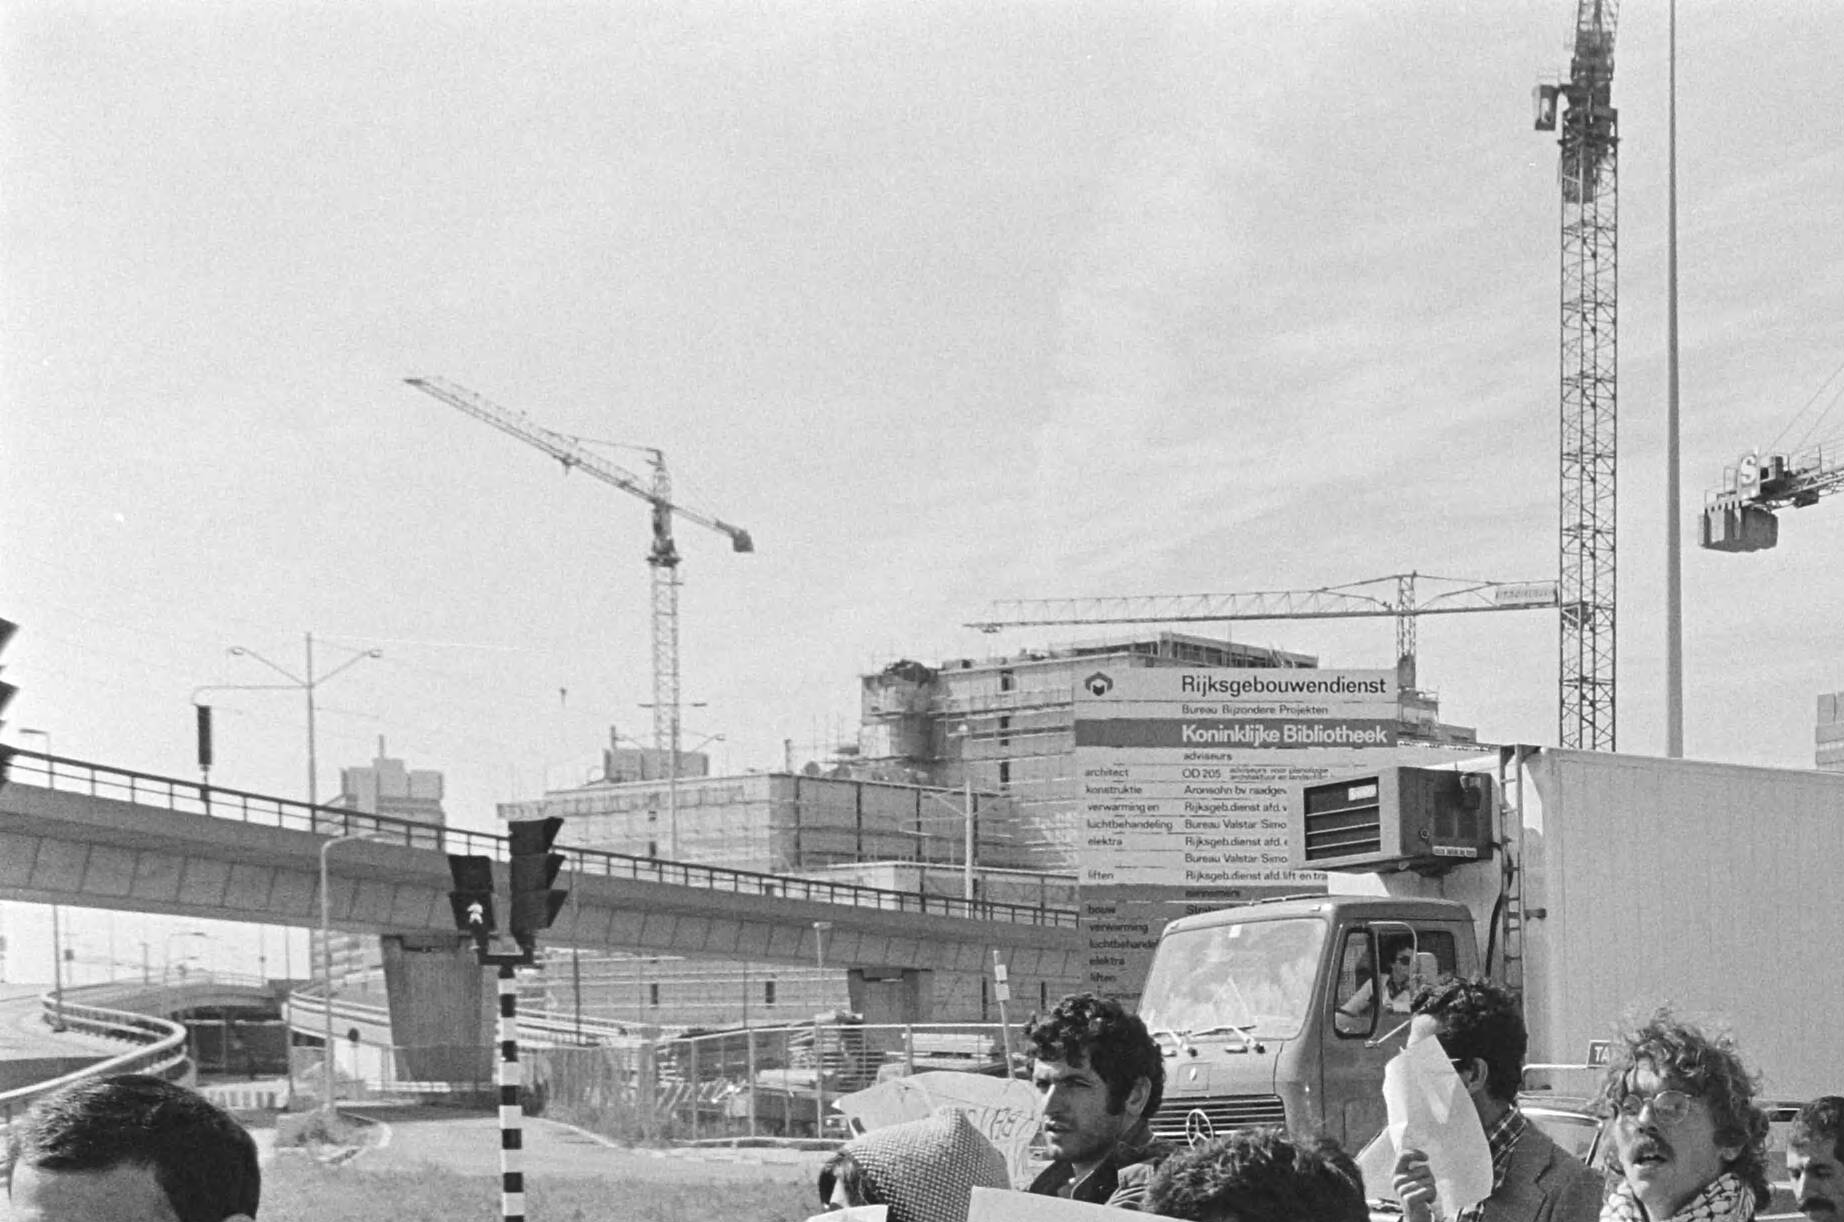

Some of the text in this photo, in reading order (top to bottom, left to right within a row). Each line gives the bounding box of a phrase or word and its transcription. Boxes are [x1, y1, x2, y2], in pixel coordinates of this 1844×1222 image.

[1181, 674, 1387, 698] Rijksgebouwendienst
[1181, 704, 1329, 717] Bureau Bijzondere Projekten
[1181, 724, 1388, 744] Koninklijke Bibliotheek
[1183, 751, 1233, 761] adviseurs
[1084, 767, 1129, 777] architect
[1202, 768, 1222, 778] 205
[1086, 784, 1143, 795] konstruktie
[1183, 784, 1233, 795] Aronsohn
[1087, 803, 1160, 813] verwarming en
[1087, 818, 1173, 831] luchtbehandeling
[1184, 820, 1221, 830] Bureau
[1223, 819, 1258, 830] Valstar
[1087, 837, 1123, 847] elektra
[1184, 853, 1221, 863] Bureau
[1223, 852, 1258, 863] Valstar
[1087, 870, 1114, 881] liften
[1299, 872, 1311, 881] en
